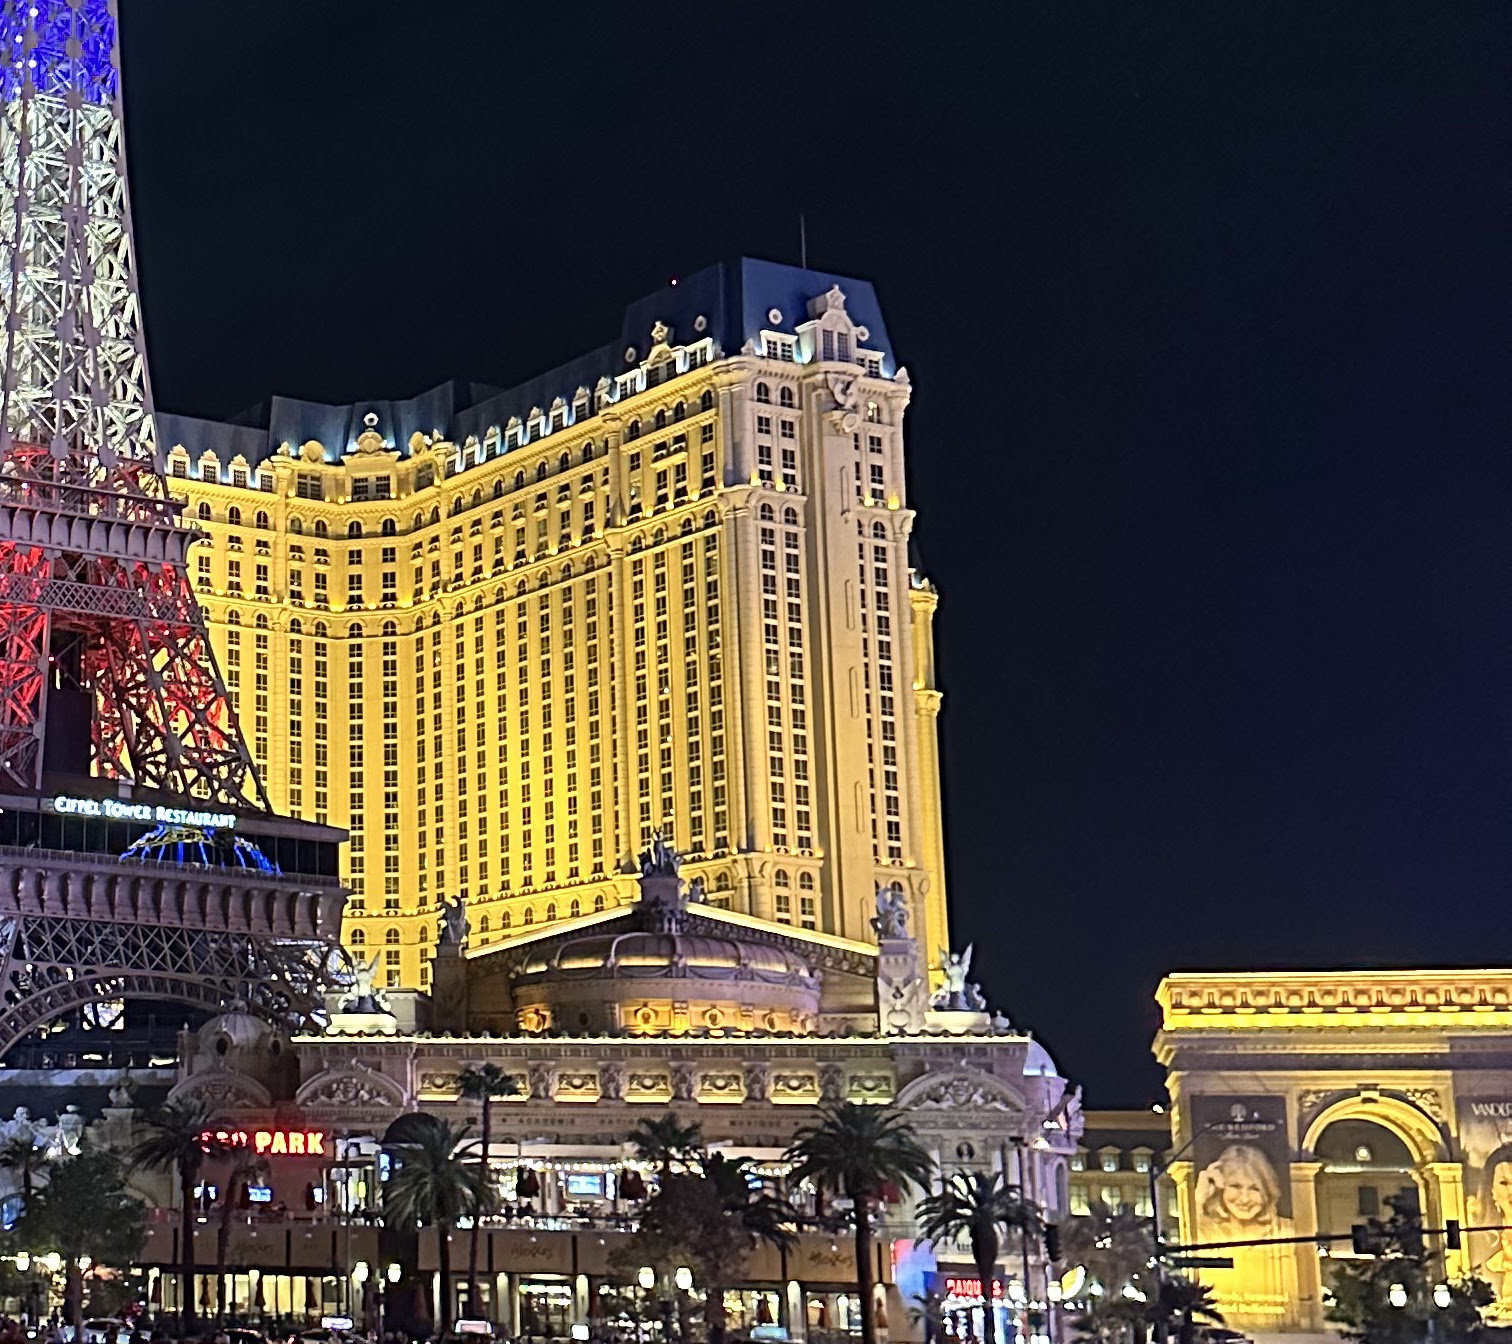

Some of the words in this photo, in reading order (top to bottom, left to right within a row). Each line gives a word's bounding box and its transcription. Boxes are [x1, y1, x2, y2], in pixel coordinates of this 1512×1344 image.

[103, 798, 152, 820] TOWER
[156, 805, 237, 829] RESTAURANT
[254, 1131, 325, 1154] PARK
